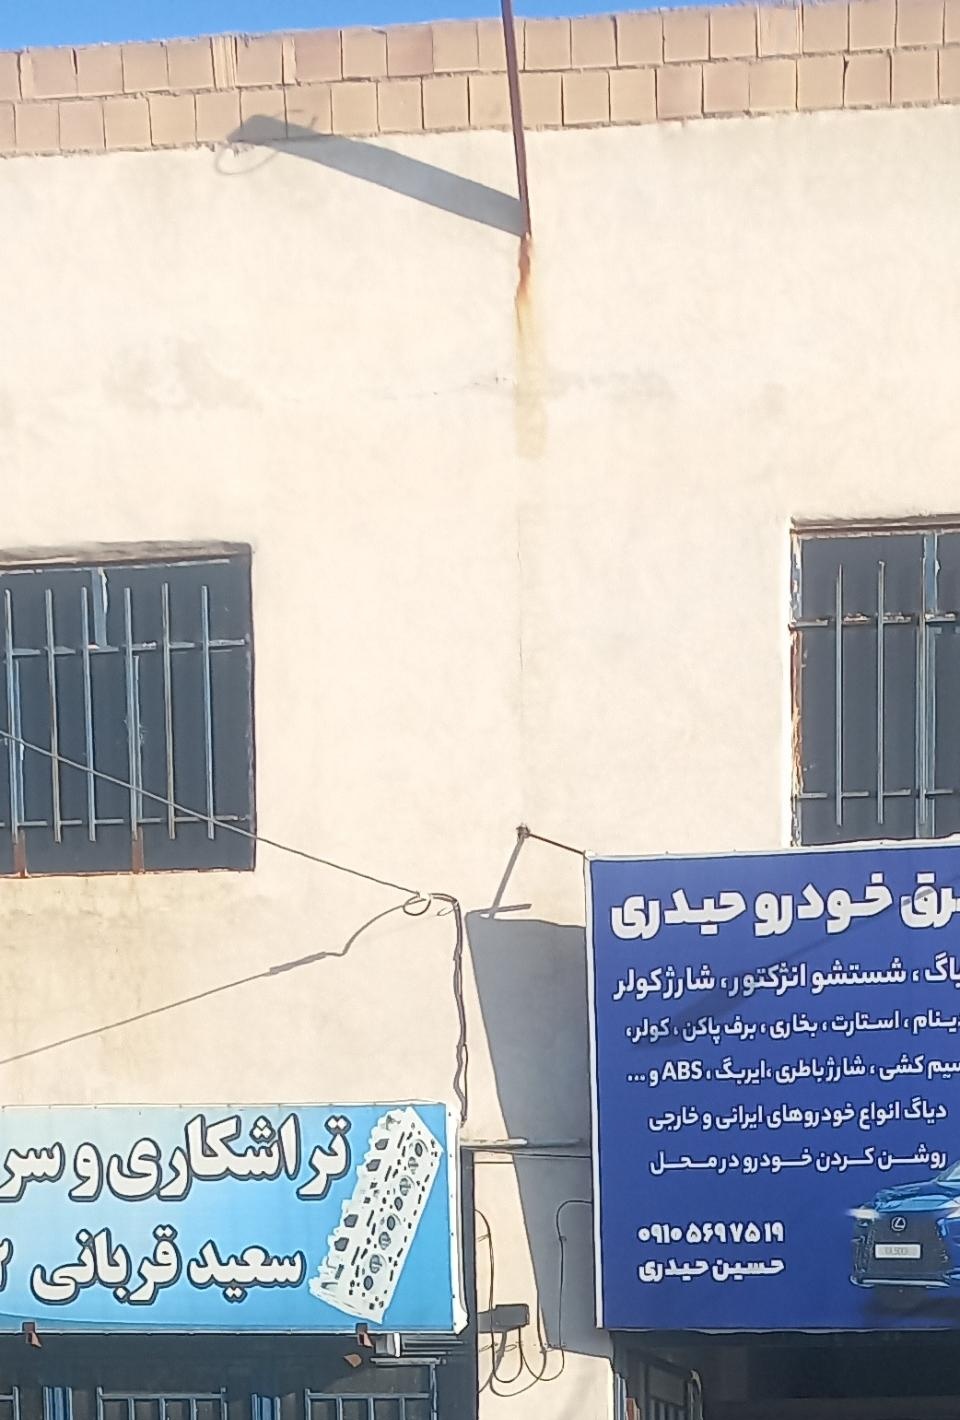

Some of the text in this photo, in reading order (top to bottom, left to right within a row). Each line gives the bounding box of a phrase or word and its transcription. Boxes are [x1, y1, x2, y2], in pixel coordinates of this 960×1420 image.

[610, 888, 747, 940] حیدری
[754, 872, 894, 938] خودرو
[811, 956, 907, 994] شستشو
[724, 1015, 757, 1040] برف
[649, 1069, 659, 1087] و
[661, 1060, 703, 1081] ABS
[649, 1096, 947, 1131] دیاگ انواع خودروهای ایرانی و خارجی
[743, 1148, 813, 1173] خودرو
[815, 1147, 875, 1172] کردن
[877, 1143, 947, 1170] روشن
[69, 1142, 102, 1202] و
[637, 1222, 683, 1244] ۰۹۱۰
[30, 1224, 183, 1305] قربانی
[187, 1239, 307, 1302] سعید
[637, 1258, 786, 1282] حسین حیدری
